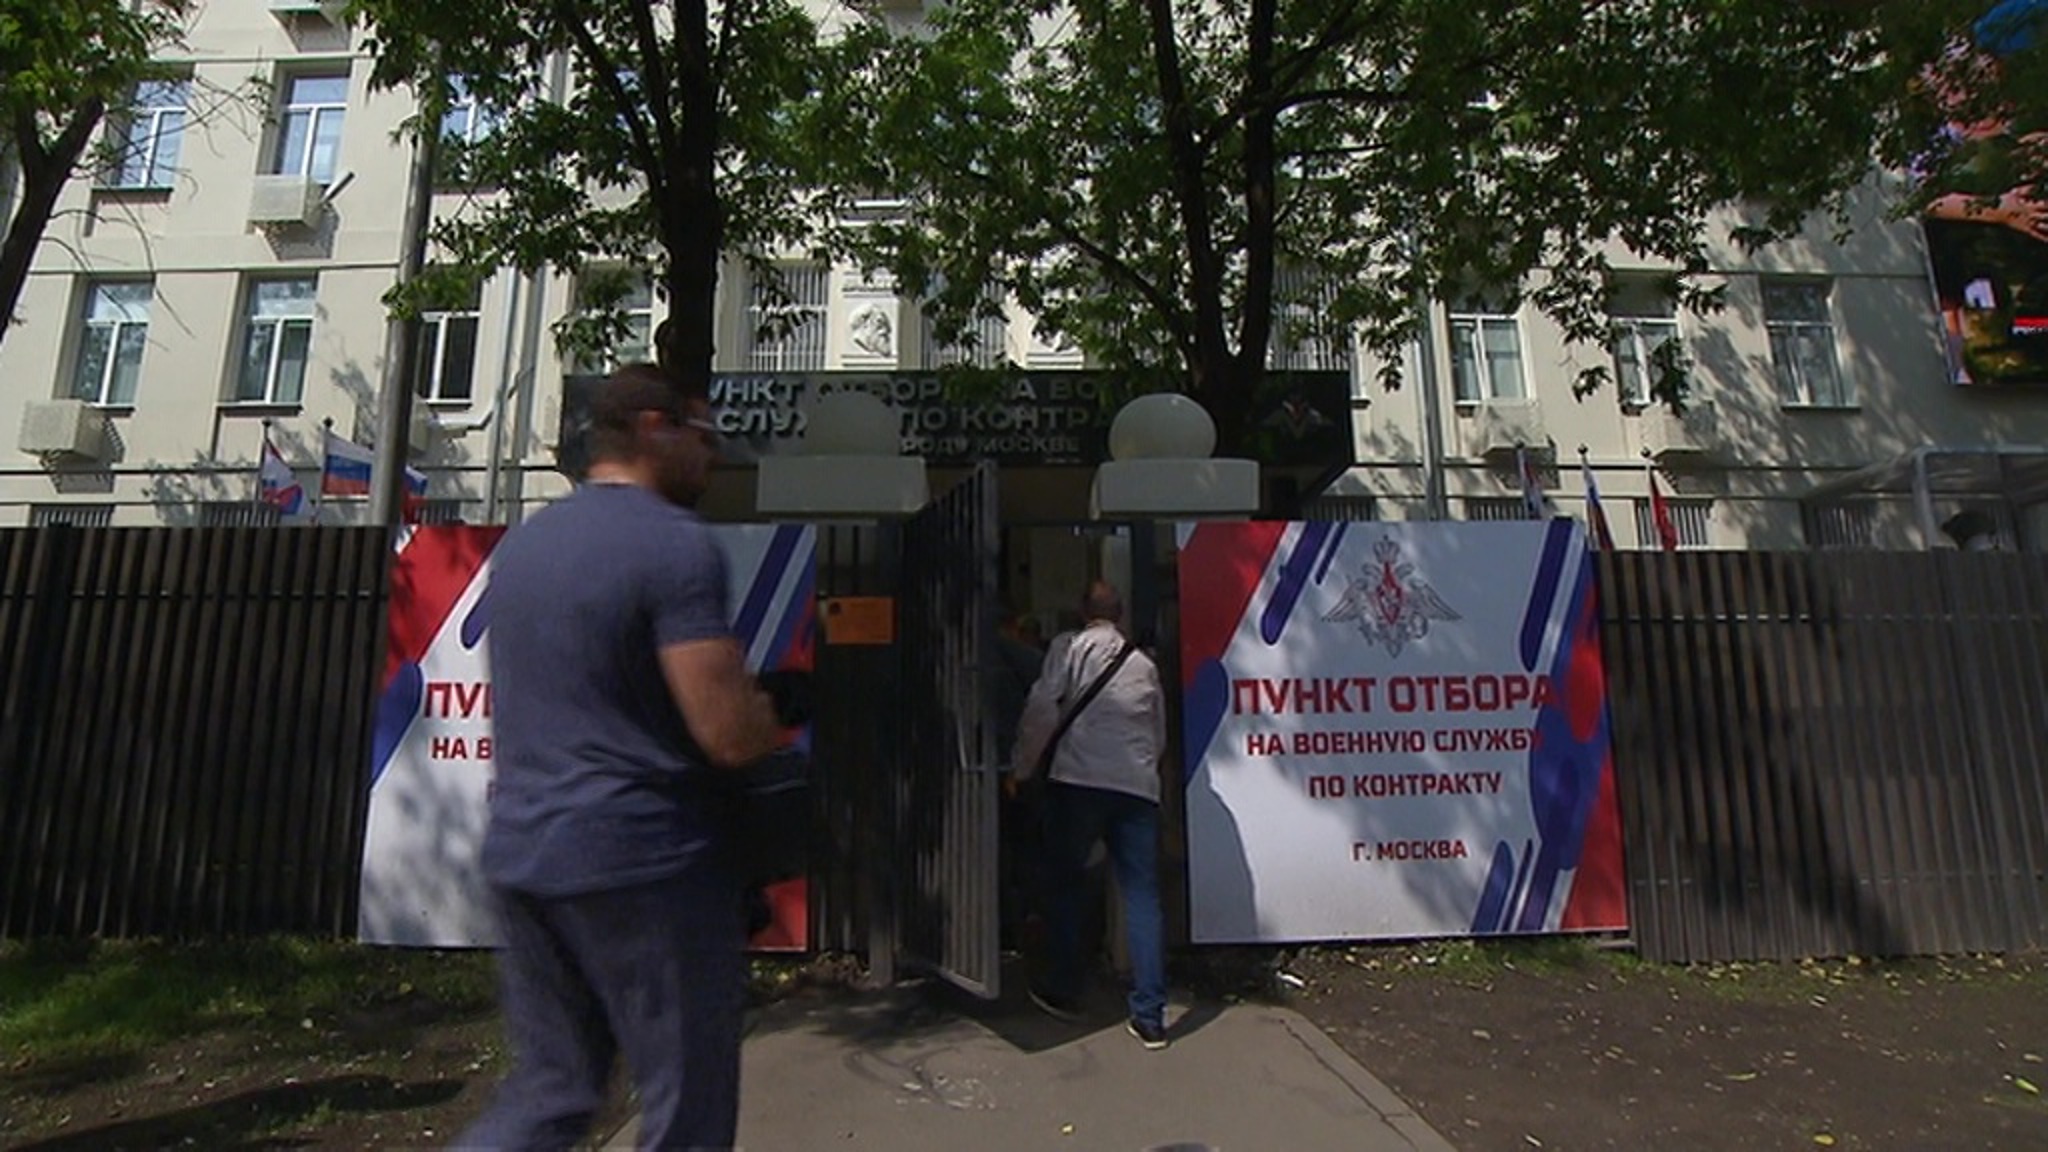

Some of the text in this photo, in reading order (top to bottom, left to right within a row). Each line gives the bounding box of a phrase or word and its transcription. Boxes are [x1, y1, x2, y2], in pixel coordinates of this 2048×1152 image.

[709, 379, 803, 402] УНКТ
[896, 407, 947, 431] ПО
[960, 406, 1092, 431] КОНТР
[1232, 675, 1557, 714] ПУНКТ ОТБОРА
[431, 737, 468, 759] НА
[1247, 728, 1543, 755] НА ВОЕННУЮ СЛУЖБУ
[1309, 771, 1501, 798] ПО КОНТРАКТУ
[1353, 839, 1468, 861] Г. МОСКВА
